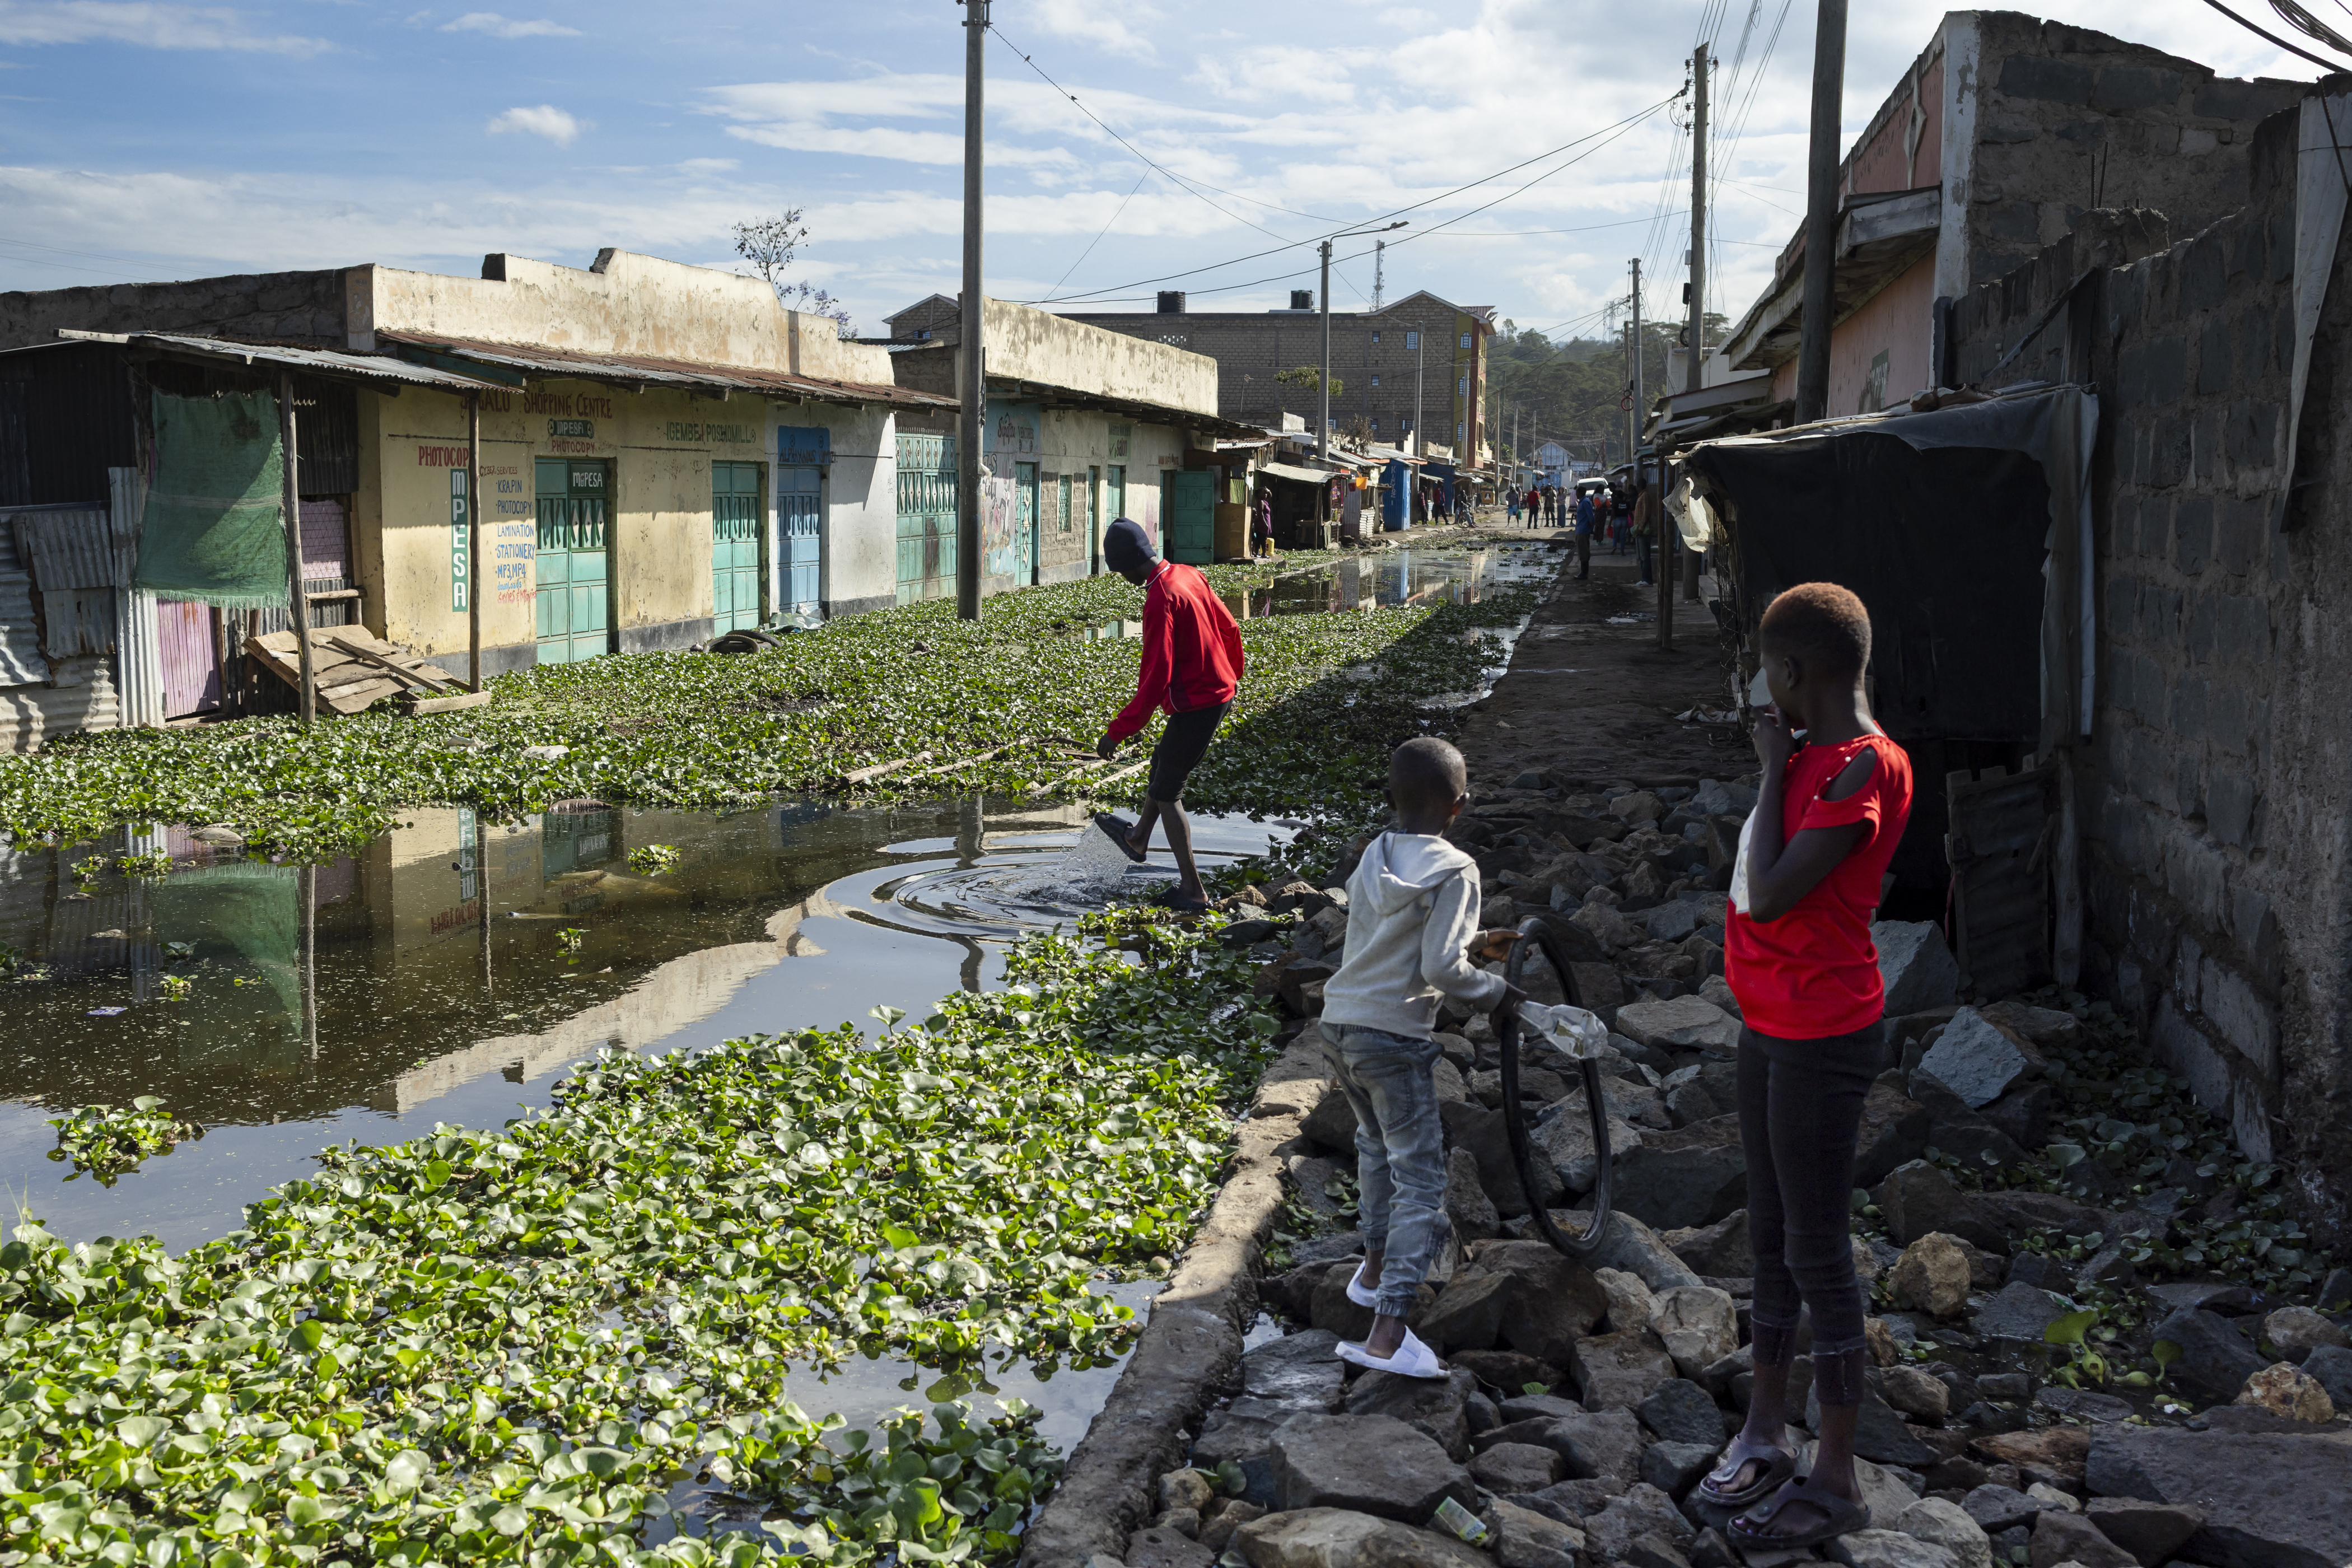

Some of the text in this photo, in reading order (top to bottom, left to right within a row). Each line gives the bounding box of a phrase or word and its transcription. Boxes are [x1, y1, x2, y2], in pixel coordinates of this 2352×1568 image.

[524, 388, 572, 417] SHOPPING
[576, 392, 613, 419] CENTRE
[557, 421, 584, 435] MPESA
[552, 440, 595, 454] PHOTOCOPY
[418, 446, 470, 467] PHOTOCOP
[479, 465, 518, 477] CYBER SERVICES
[497, 500, 532, 515] PHOTOCOPY
[497, 524, 534, 538] LAMINATION
[497, 543, 535, 560] STATIONERY
